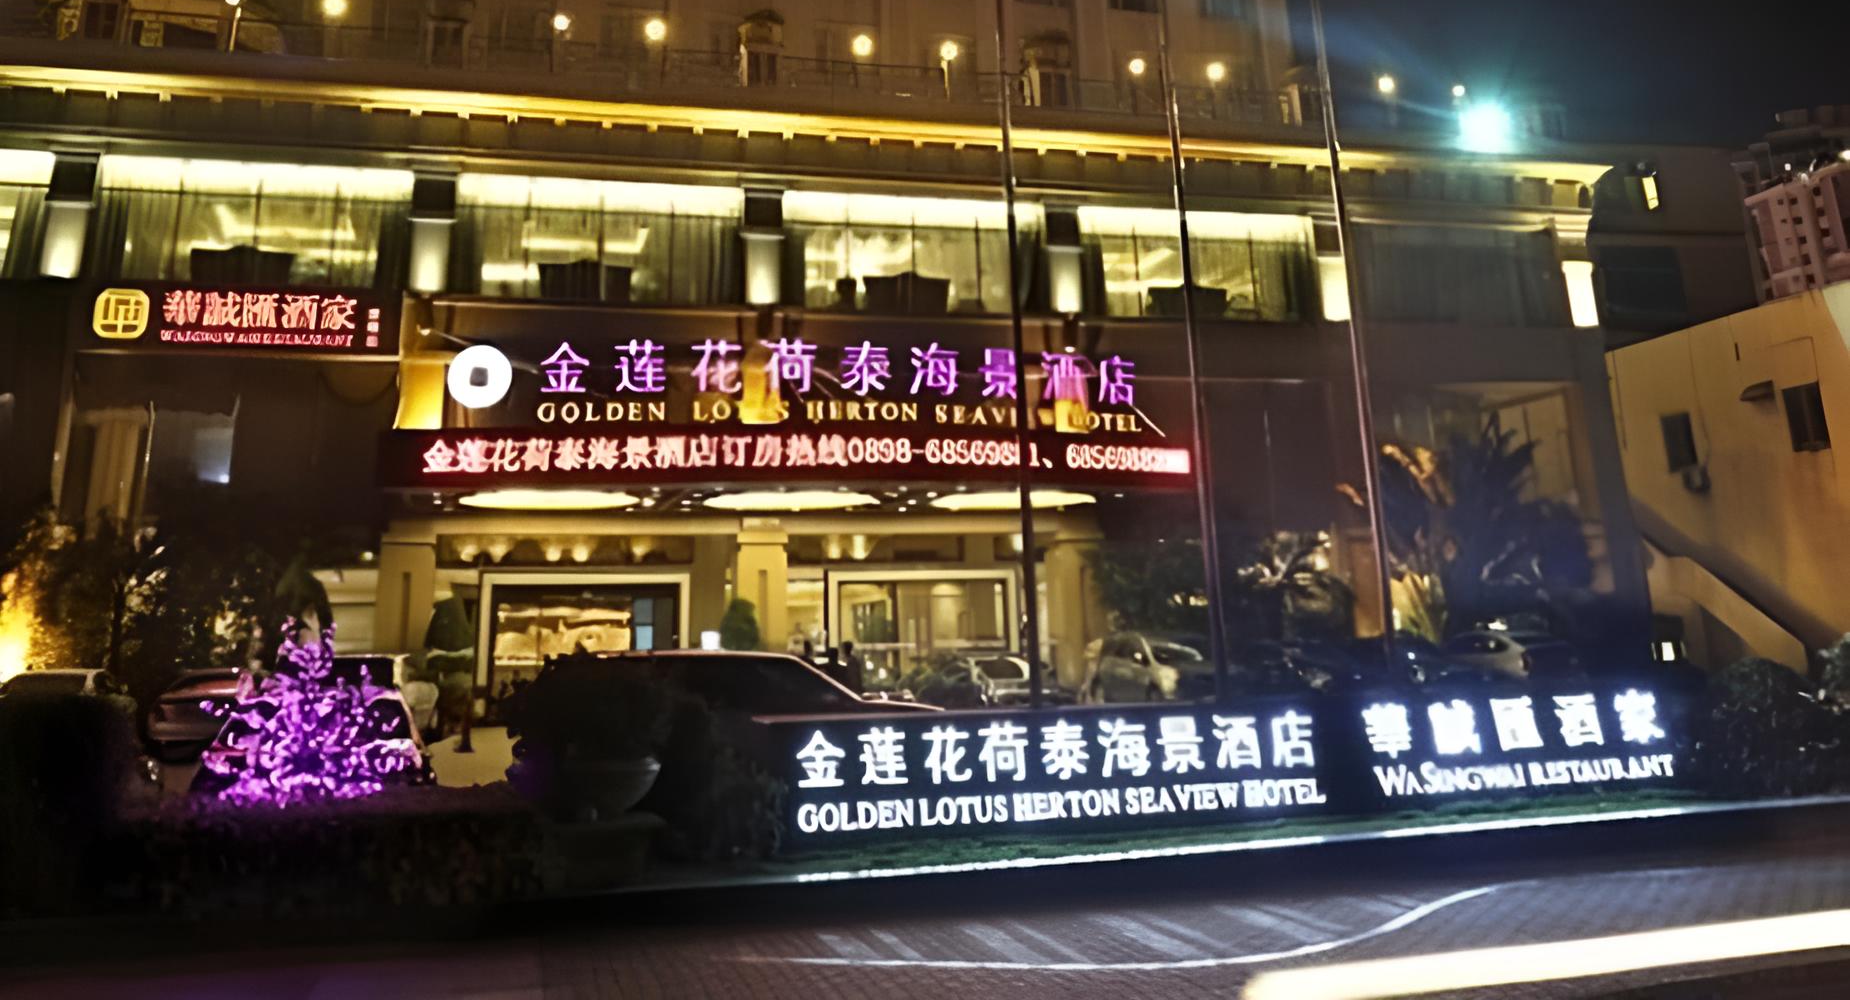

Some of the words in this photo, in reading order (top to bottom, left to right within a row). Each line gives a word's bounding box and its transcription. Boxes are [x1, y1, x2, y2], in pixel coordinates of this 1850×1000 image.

[540, 338, 1135, 405] 金莲花荷泰海景酒店
[536, 402, 665, 424] GOLDEN
[806, 401, 918, 424] HERTON
[796, 709, 1315, 788] 金莲花荷泰海景酒店
[797, 799, 914, 833] GOLDEN
[918, 794, 1009, 827] LOTUS
[1013, 788, 1122, 822] HERTON
[1124, 783, 1240, 815] SEAVIEW
[1241, 778, 1327, 808] HOTEL
